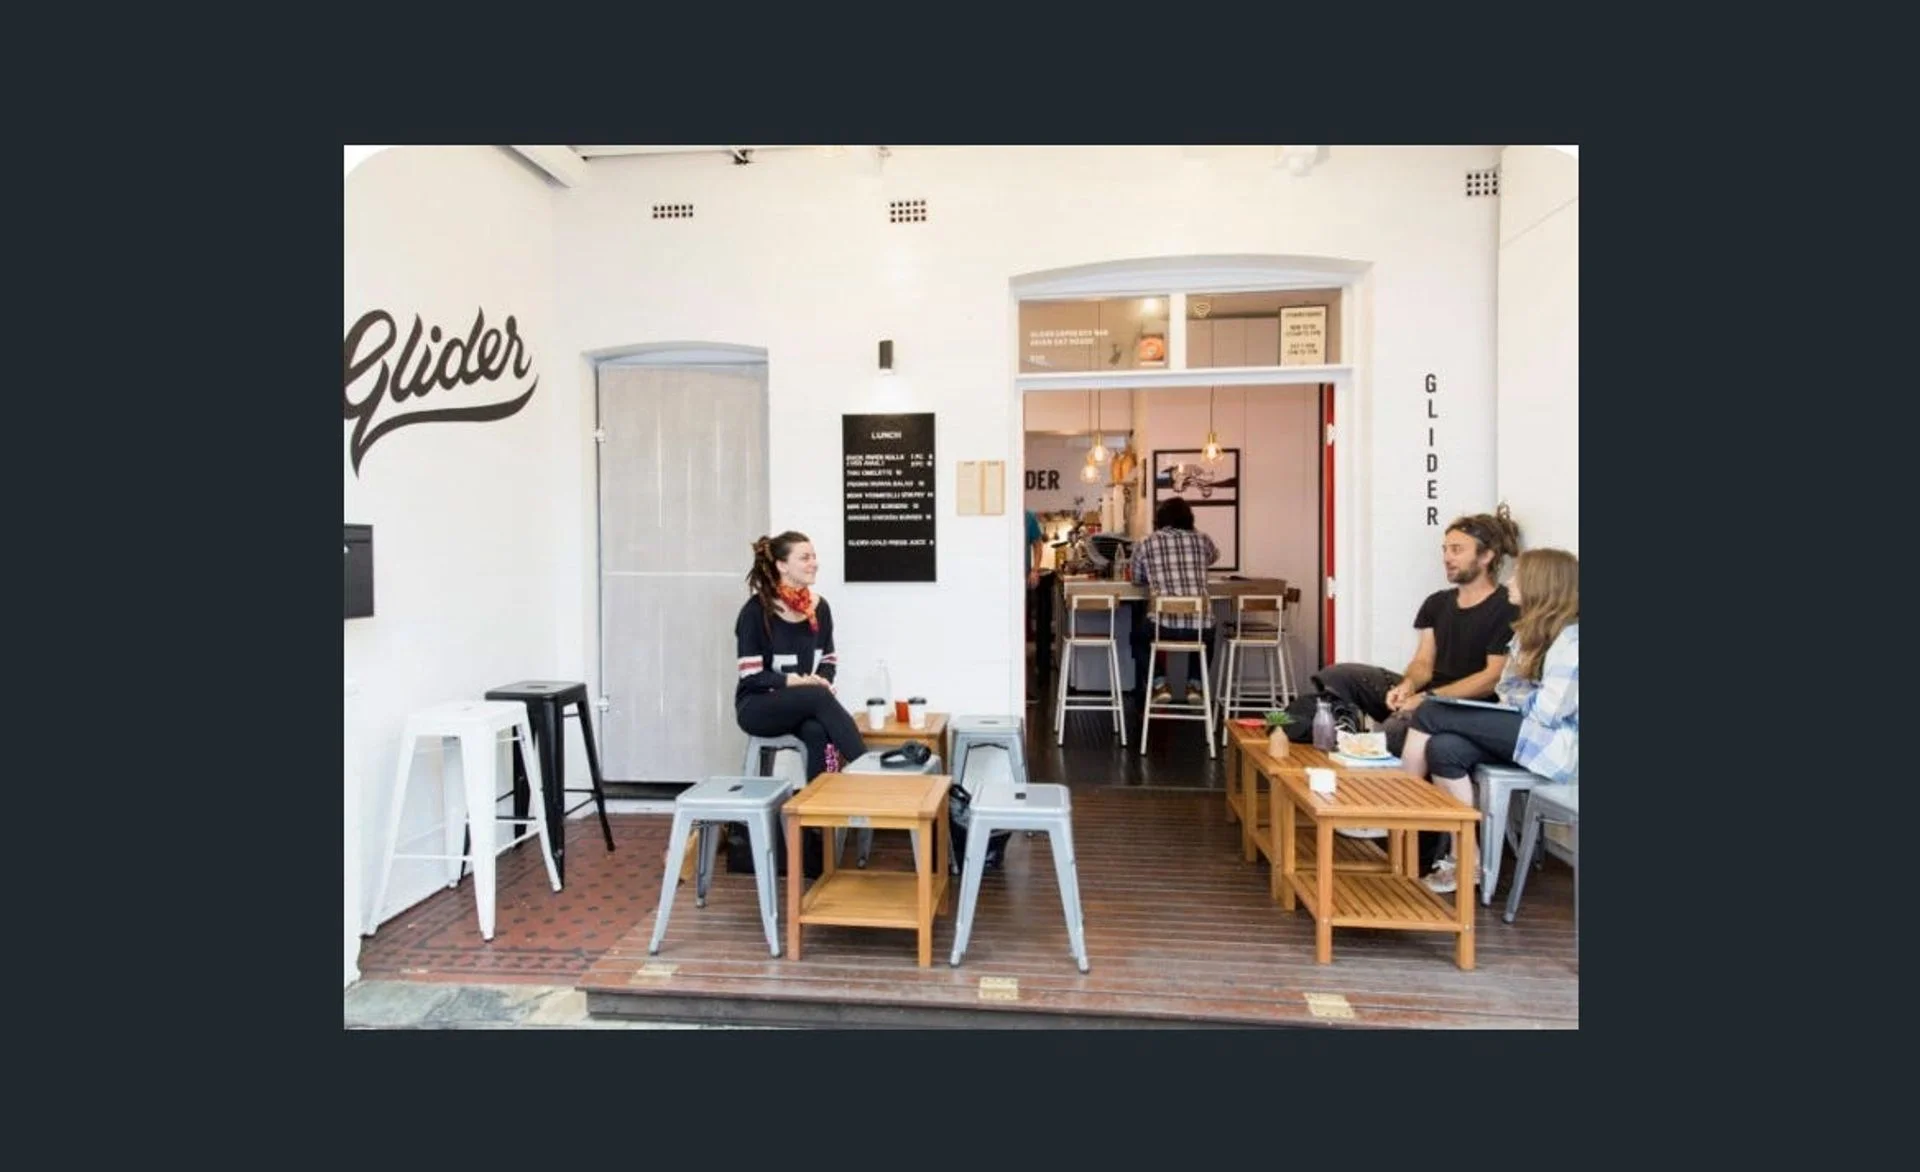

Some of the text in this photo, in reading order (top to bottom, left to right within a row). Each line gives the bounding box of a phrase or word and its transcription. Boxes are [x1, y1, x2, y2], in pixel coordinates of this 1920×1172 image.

[344, 305, 540, 480] Glider
[870, 431, 902, 440] LUNCH
[1425, 373, 1439, 526] GLIDER
